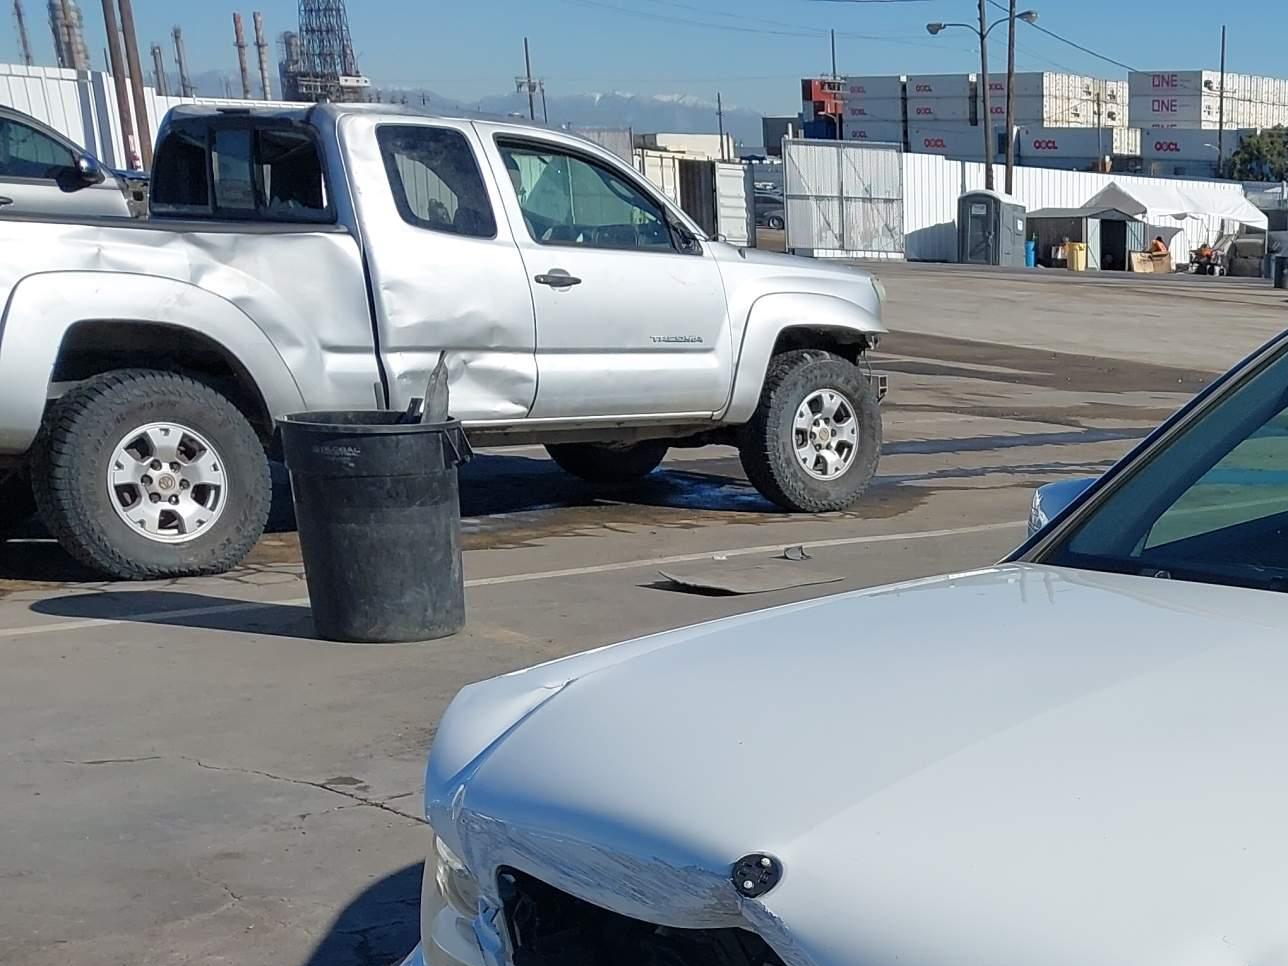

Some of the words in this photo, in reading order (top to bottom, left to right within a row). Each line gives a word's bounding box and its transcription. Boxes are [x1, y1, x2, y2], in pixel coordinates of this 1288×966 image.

[1151, 73, 1178, 88] ONE
[1151, 98, 1178, 113] ONE
[923, 138, 946, 148] OOCL
[1033, 139, 1058, 150] OOCL
[1154, 141, 1180, 152] OOCL
